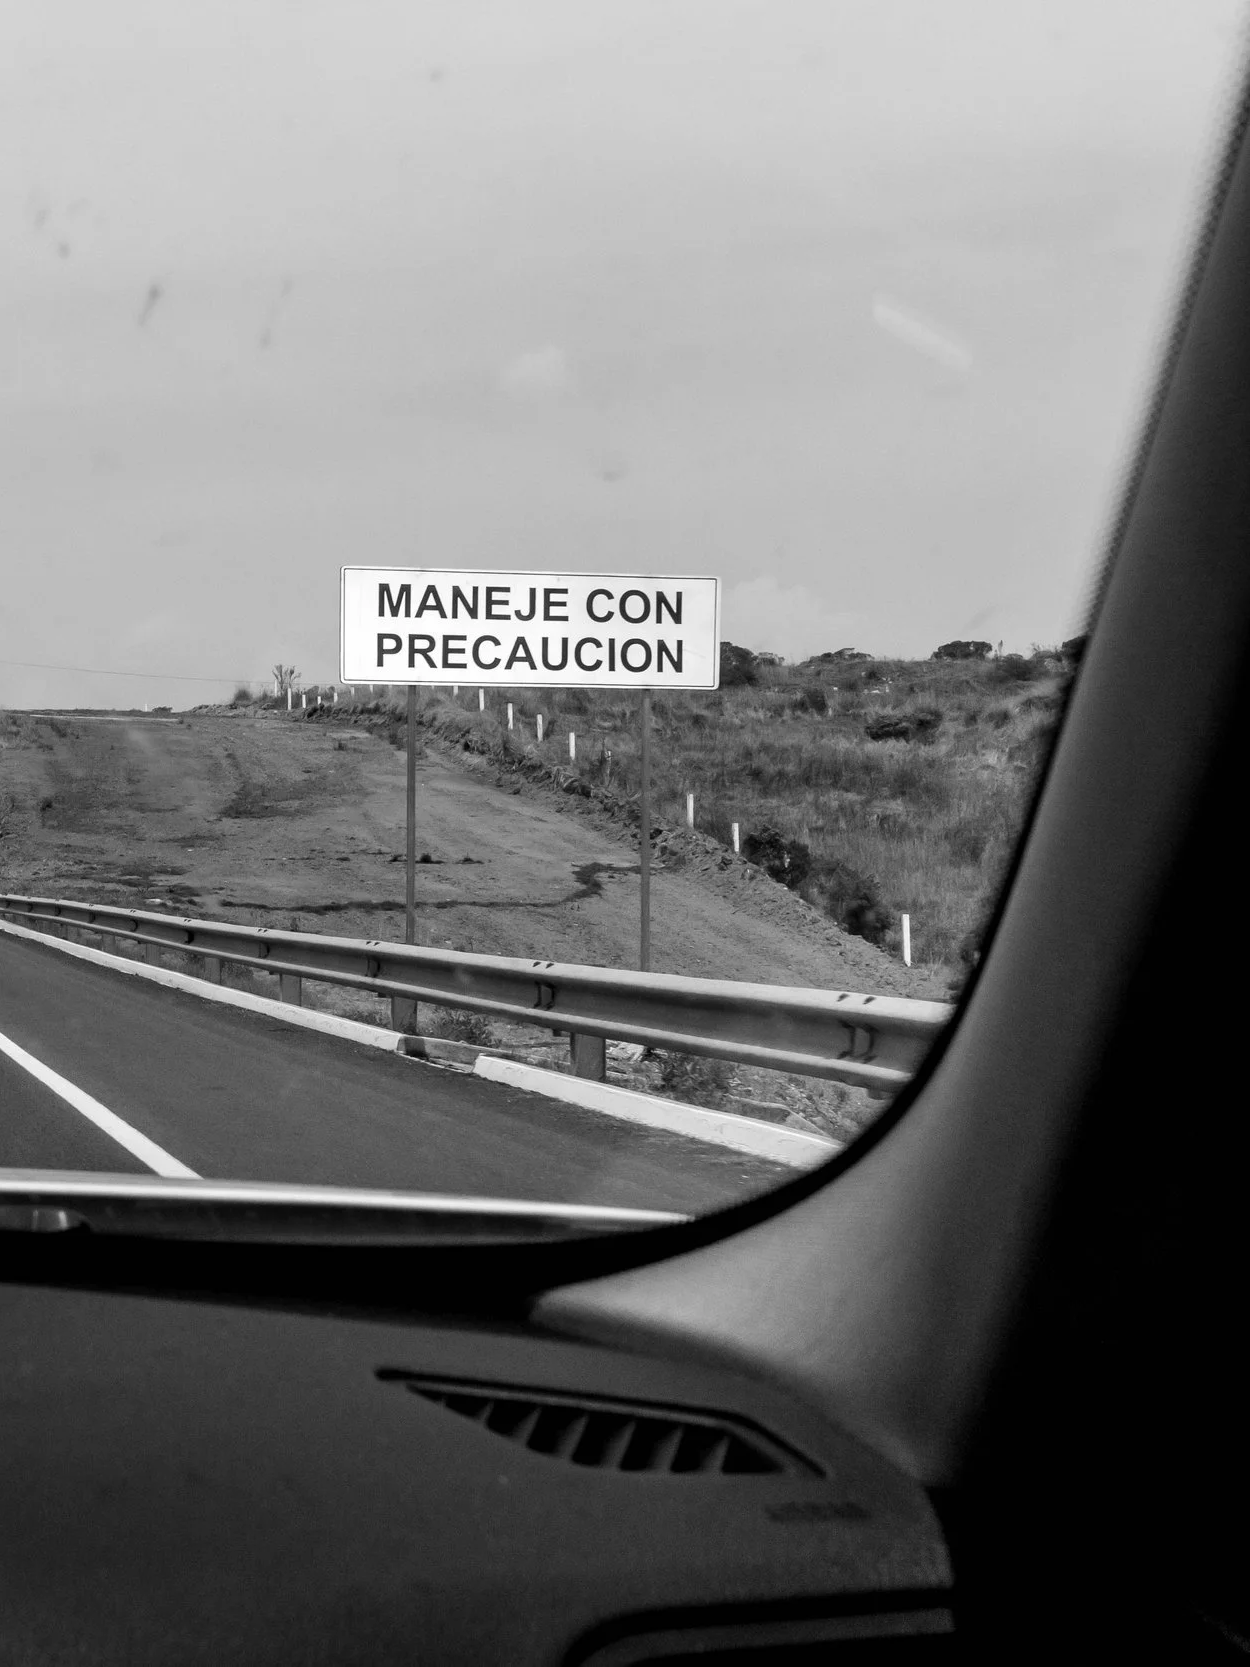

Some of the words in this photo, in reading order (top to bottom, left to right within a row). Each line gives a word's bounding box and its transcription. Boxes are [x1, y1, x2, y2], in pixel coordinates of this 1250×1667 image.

[378, 583, 569, 622] MANEJE
[586, 588, 683, 625] CON
[377, 633, 683, 673] PRECAUCION
